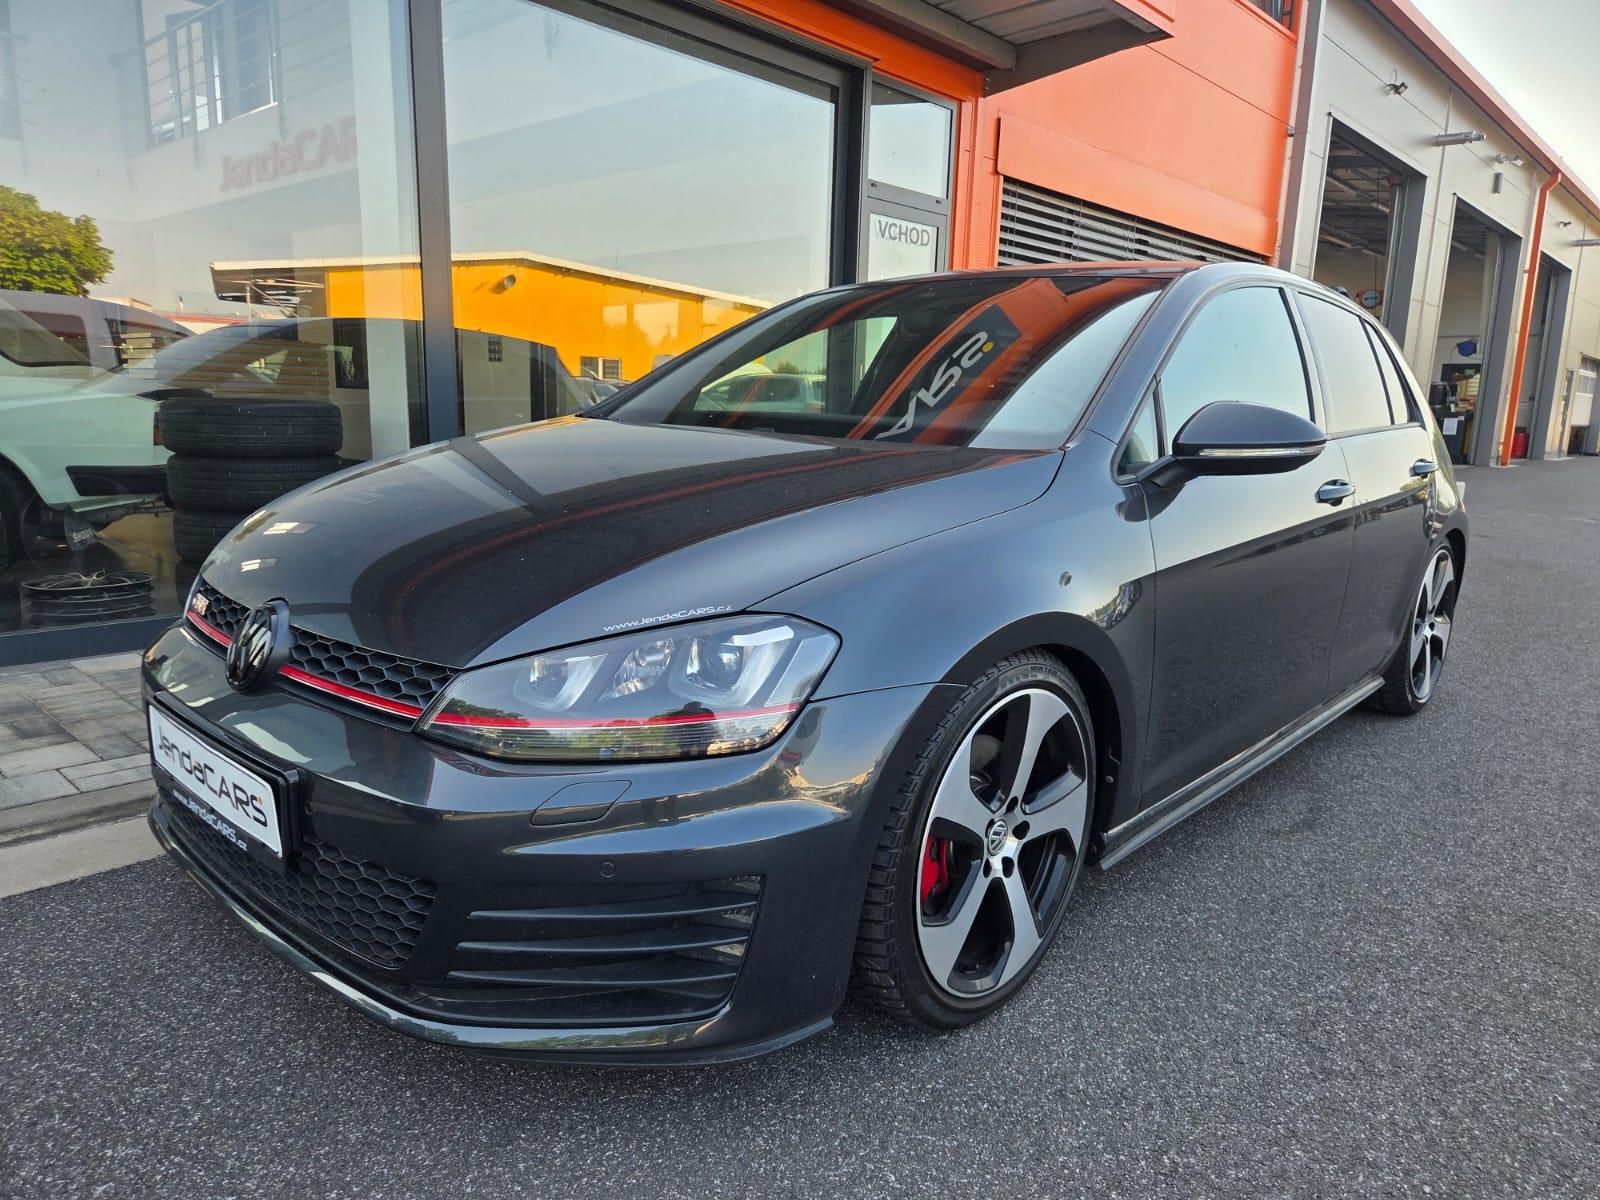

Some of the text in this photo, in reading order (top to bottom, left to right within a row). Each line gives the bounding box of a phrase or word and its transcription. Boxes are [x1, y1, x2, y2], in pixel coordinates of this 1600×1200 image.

[878, 219, 930, 247] VCHOD
[603, 605, 733, 632] www.JendaCARS.cz
[158, 726, 268, 828] JendaCARS
